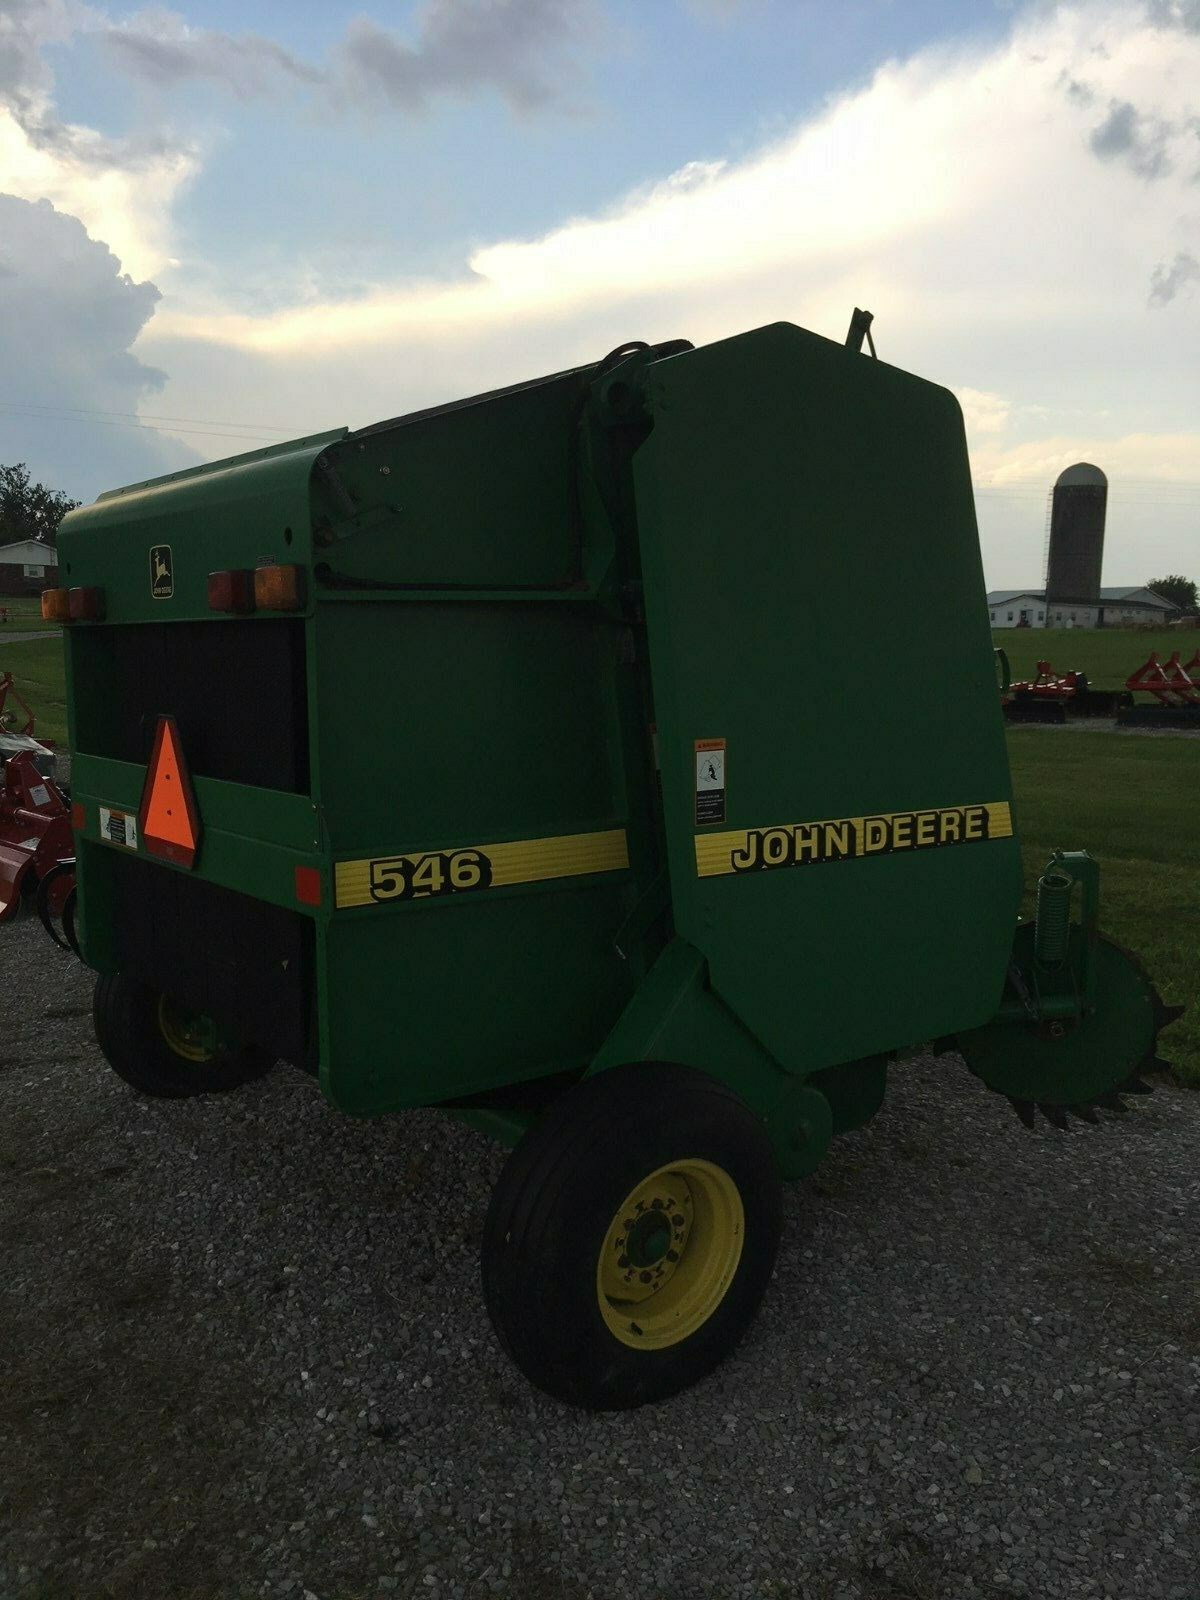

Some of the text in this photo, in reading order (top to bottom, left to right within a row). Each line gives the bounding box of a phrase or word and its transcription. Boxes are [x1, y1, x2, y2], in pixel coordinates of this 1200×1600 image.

[732, 807, 986, 871] JOHN DEERE
[371, 850, 486, 900] 546
